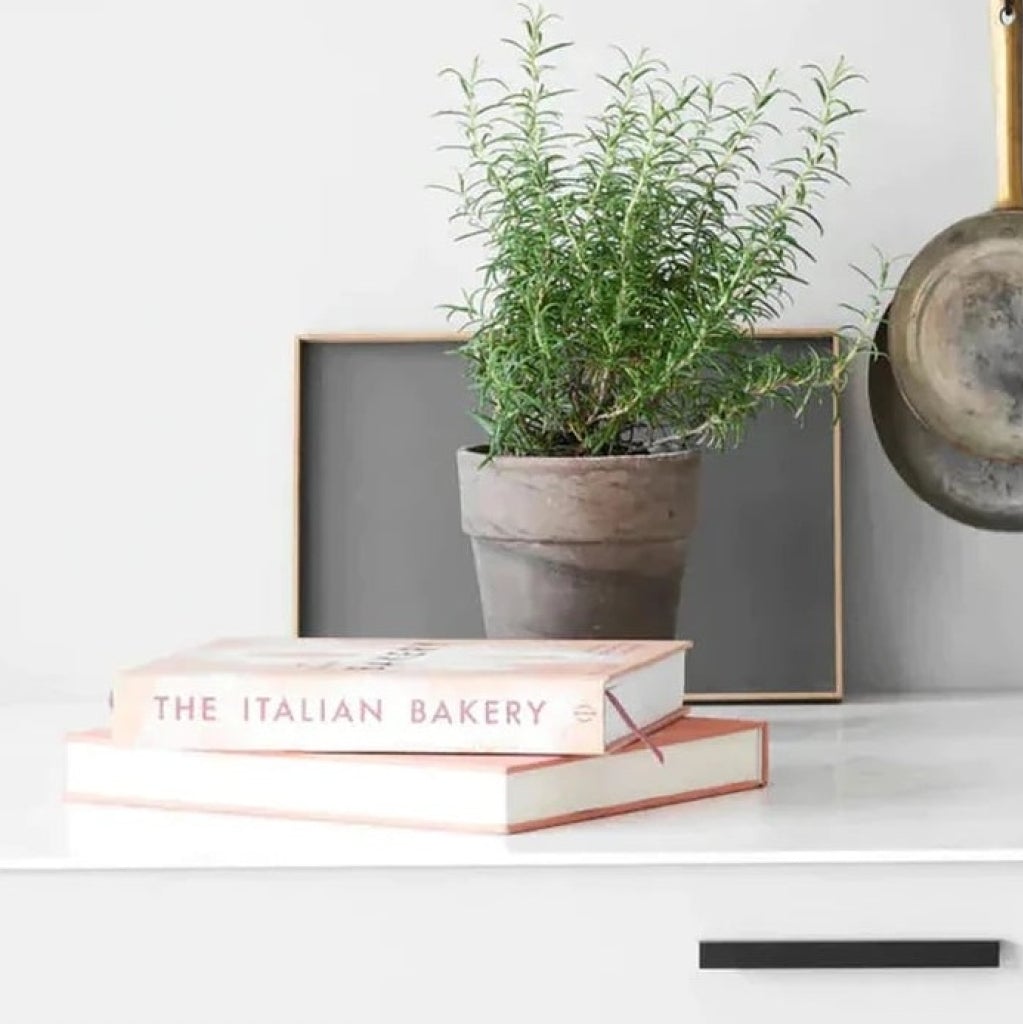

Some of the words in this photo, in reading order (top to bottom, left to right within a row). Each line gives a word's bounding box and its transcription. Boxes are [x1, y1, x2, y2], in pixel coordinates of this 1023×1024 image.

[153, 695, 217, 722] THE
[243, 696, 383, 723] ITALIAN
[410, 698, 547, 726] BAKERY
